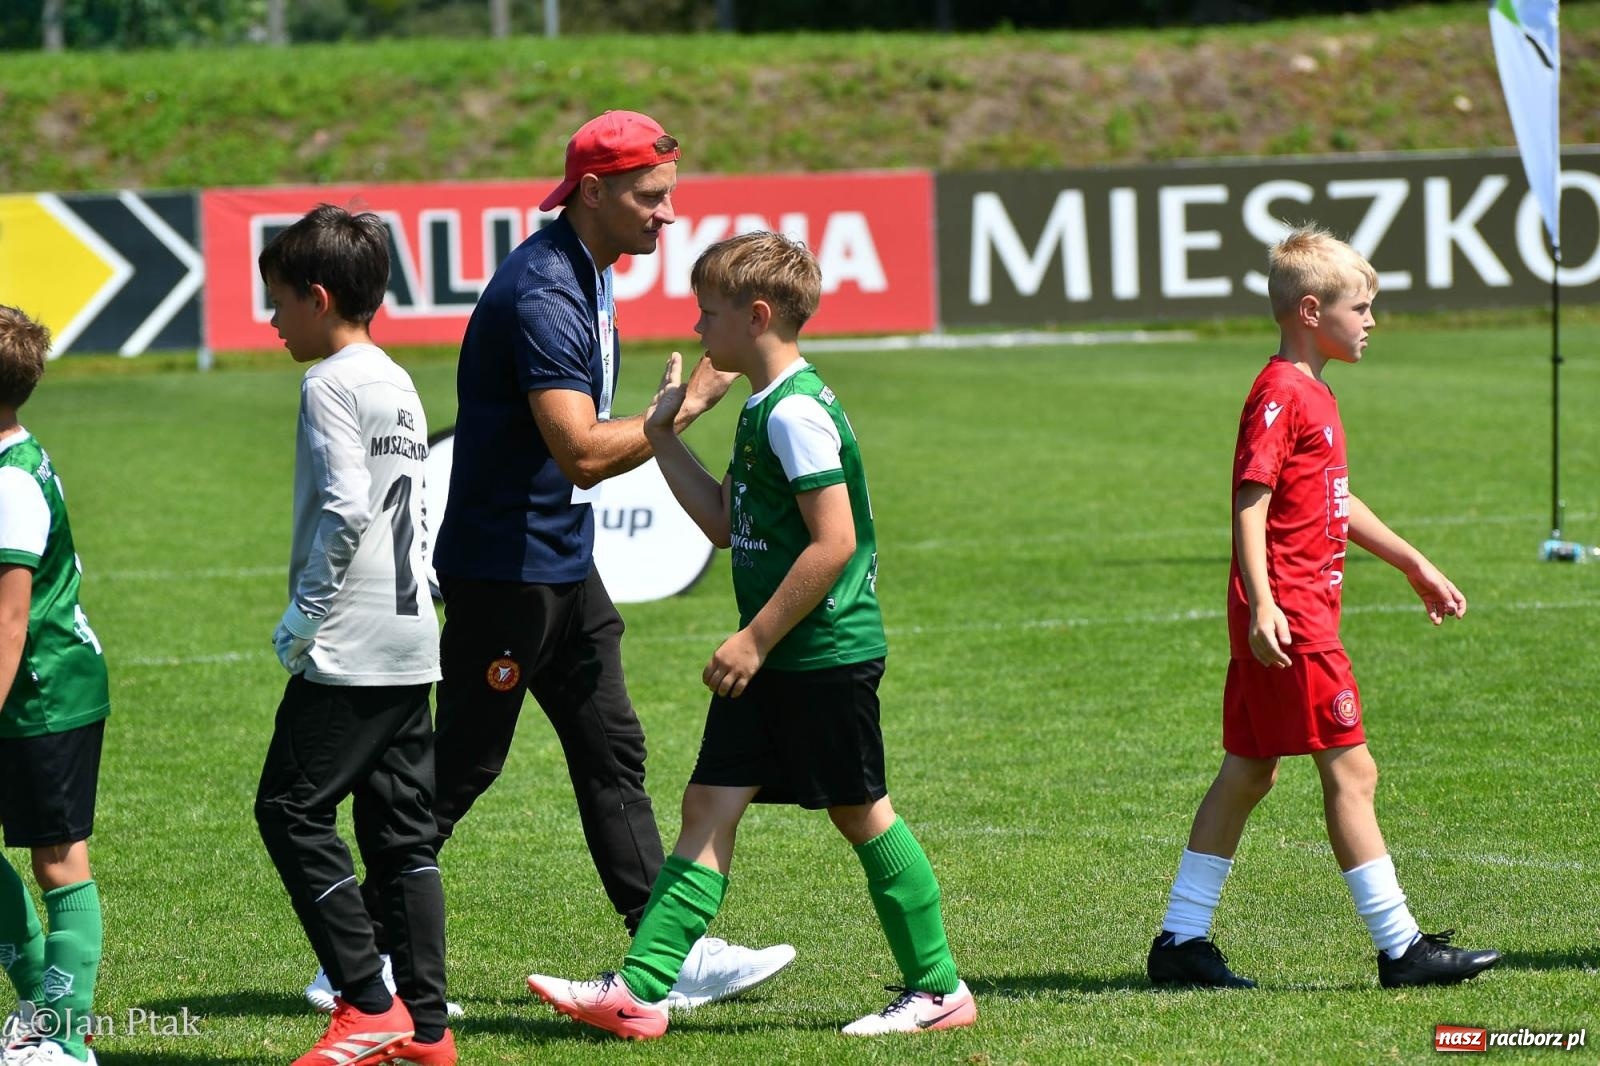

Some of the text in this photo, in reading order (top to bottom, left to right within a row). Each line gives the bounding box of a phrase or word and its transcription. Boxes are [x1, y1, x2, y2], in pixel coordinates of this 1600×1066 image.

[612, 211, 888, 301] KA
[969, 170, 1600, 304] MIESZKO
[382, 474, 419, 616] 1
[594, 508, 653, 538] up
